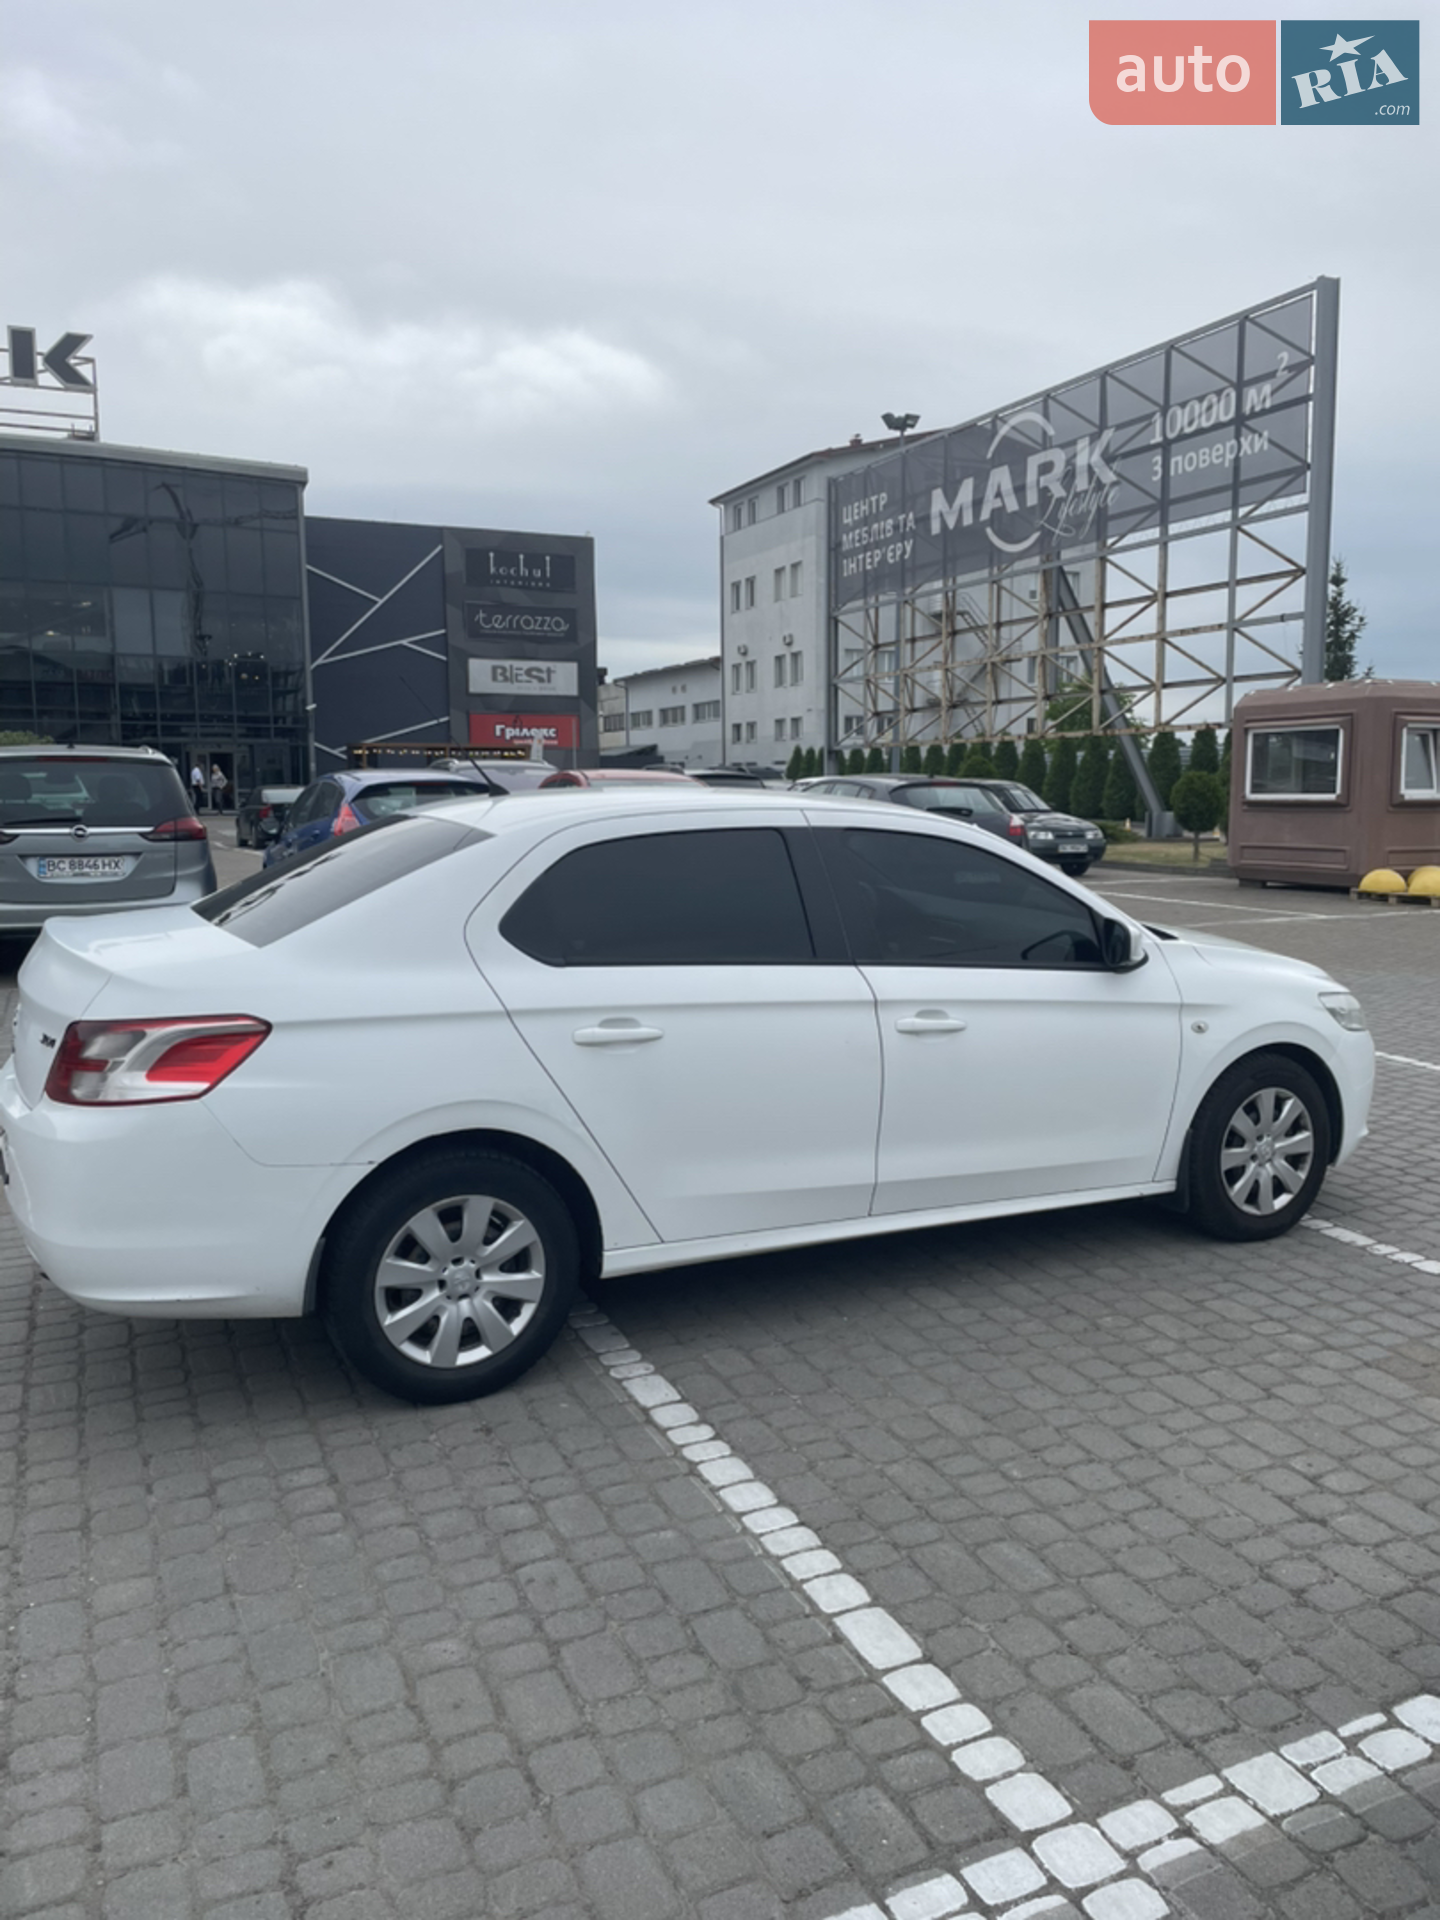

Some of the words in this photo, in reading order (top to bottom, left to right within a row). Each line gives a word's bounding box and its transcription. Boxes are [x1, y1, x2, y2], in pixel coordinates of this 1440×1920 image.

[1149, 386, 1236, 444] 10000
[1152, 456, 1163, 481] 3
[1170, 430, 1269, 477] поверхи
[930, 428, 1120, 536] MARK
[842, 492, 888, 526] ЦЕНТР
[842, 520, 893, 551] МЕБЛІВ
[898, 512, 916, 533] ТА
[47, 859, 66, 871] BC
[68, 859, 100, 871] 8846
[102, 859, 121, 871] HX
